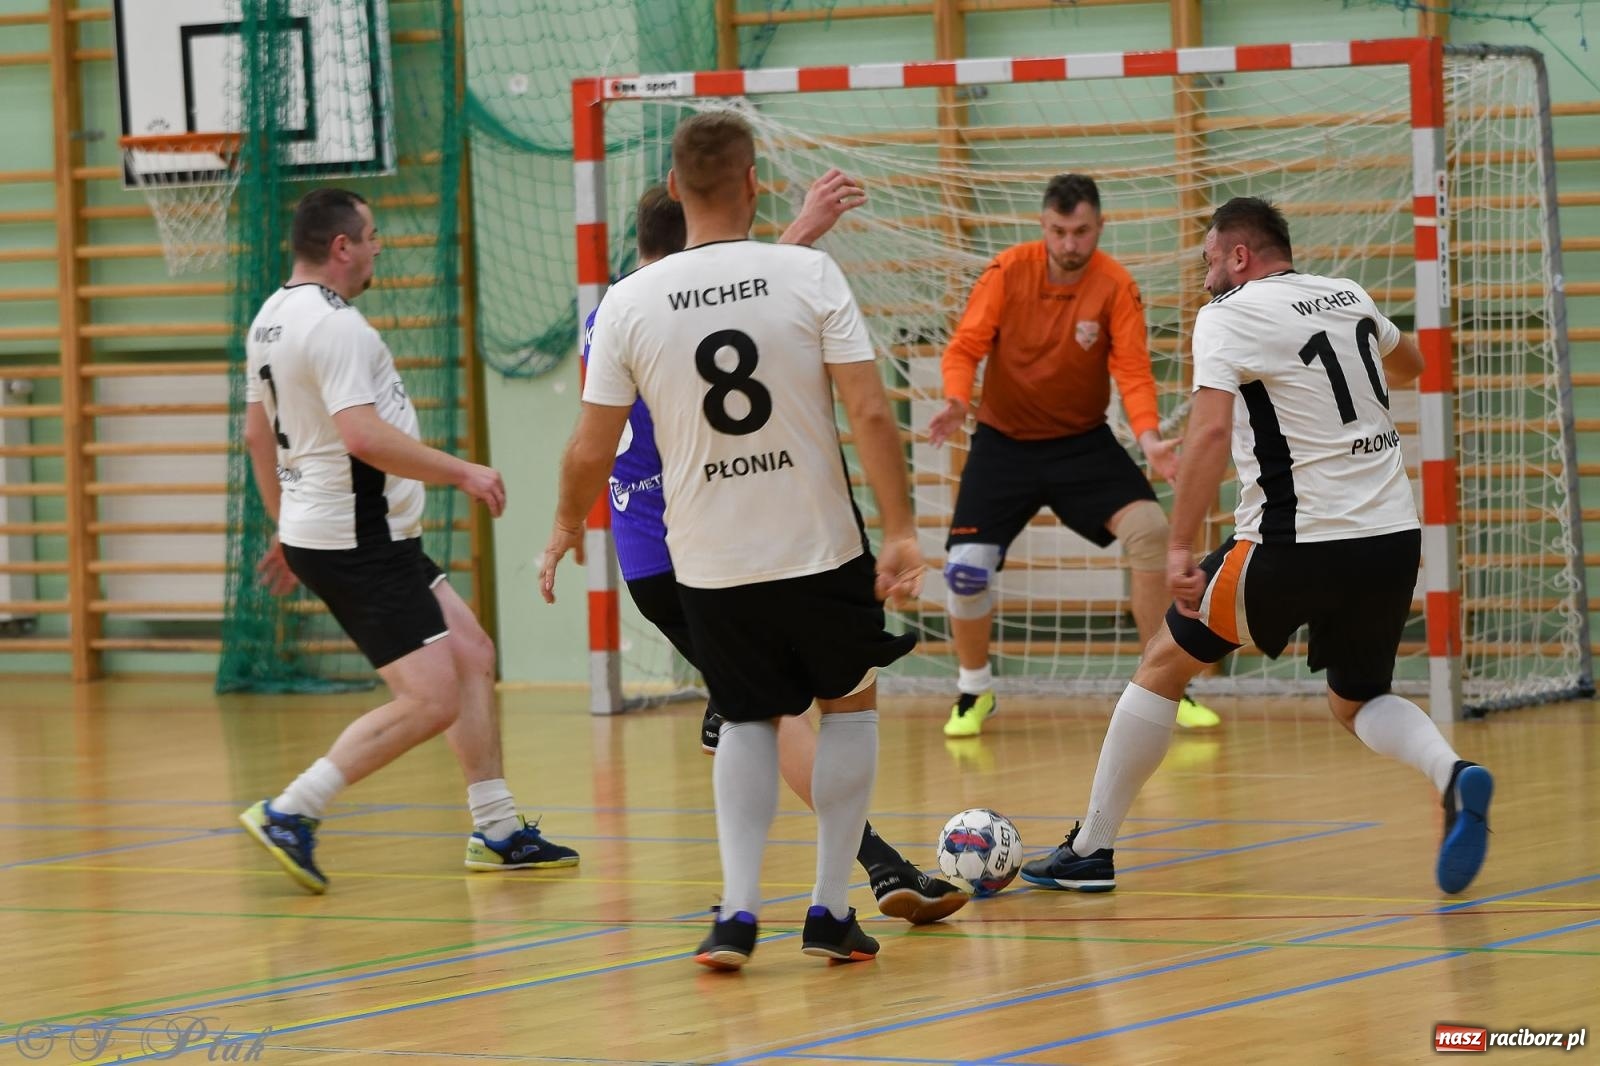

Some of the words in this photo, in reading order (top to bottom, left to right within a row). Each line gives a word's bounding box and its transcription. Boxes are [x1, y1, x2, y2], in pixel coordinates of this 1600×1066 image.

[668, 278, 769, 311] WICHER
[1291, 290, 1361, 316] WICHER
[695, 329, 772, 436] 8
[1298, 317, 1390, 425] 10
[704, 450, 794, 482] PŁONIA
[995, 826, 1011, 871] SELECT
